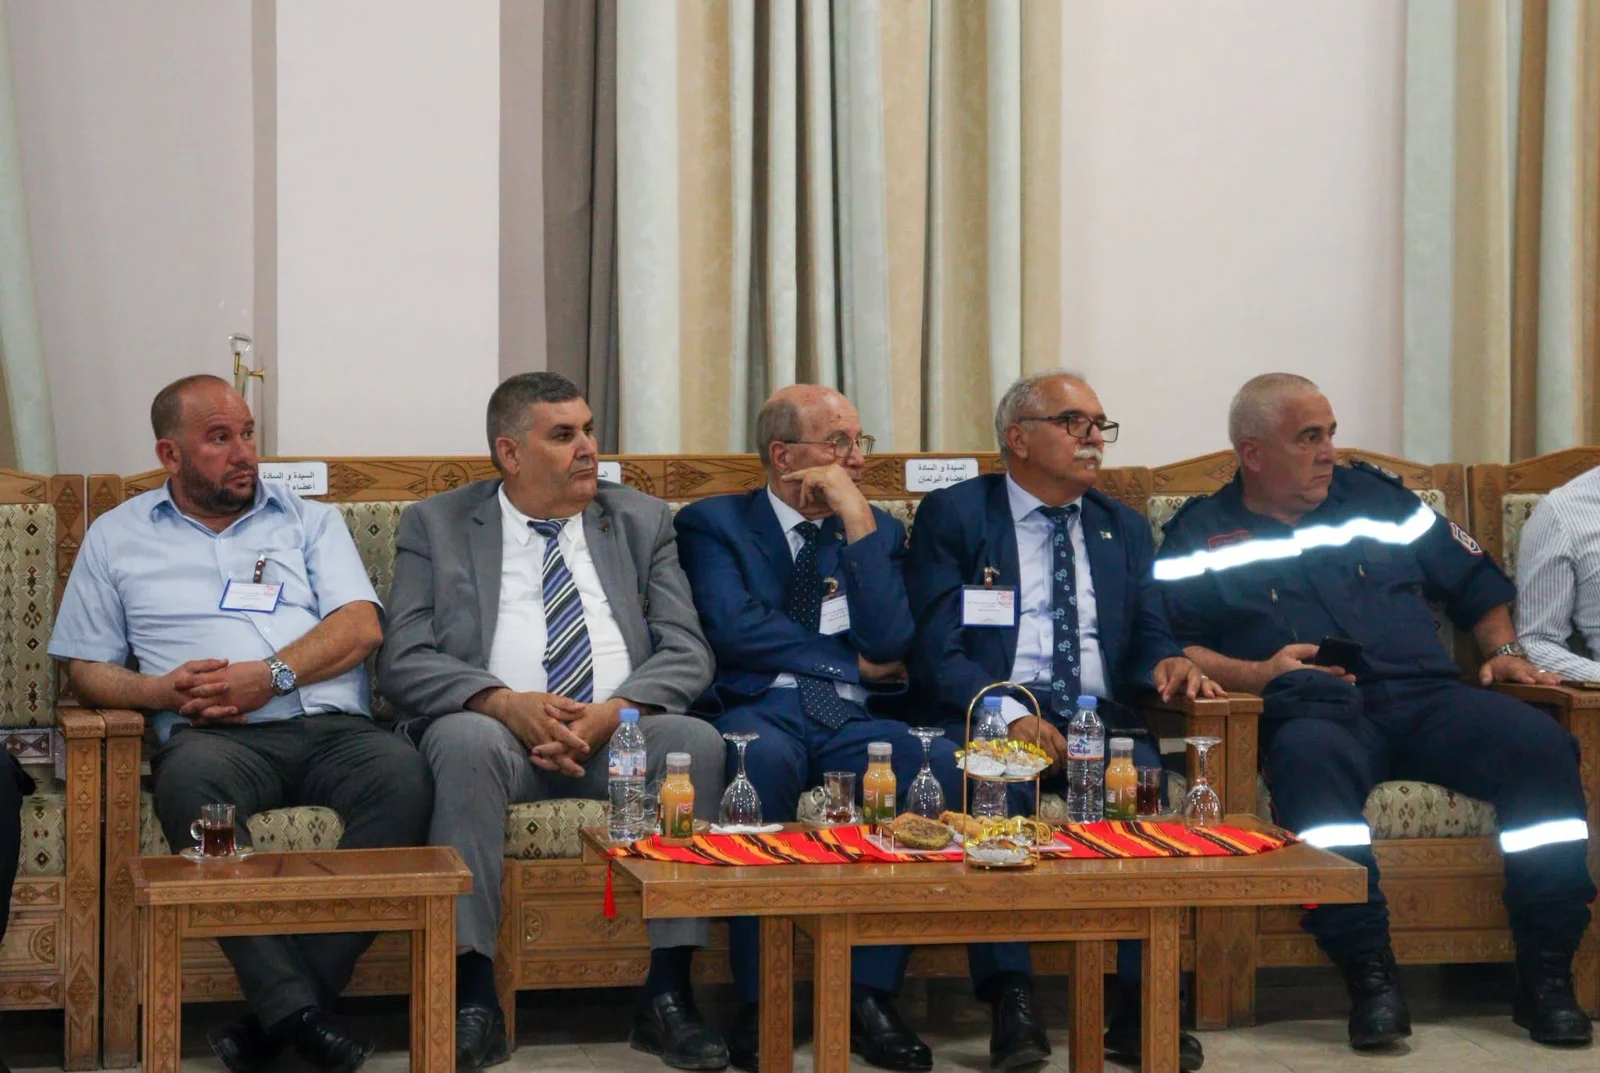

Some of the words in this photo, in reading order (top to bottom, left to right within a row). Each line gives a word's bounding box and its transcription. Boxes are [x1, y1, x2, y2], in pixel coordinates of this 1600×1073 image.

[918, 463, 938, 471] السادة
[946, 463, 967, 472] السيدة
[263, 471, 284, 479] السادة
[293, 471, 315, 480] السيدة
